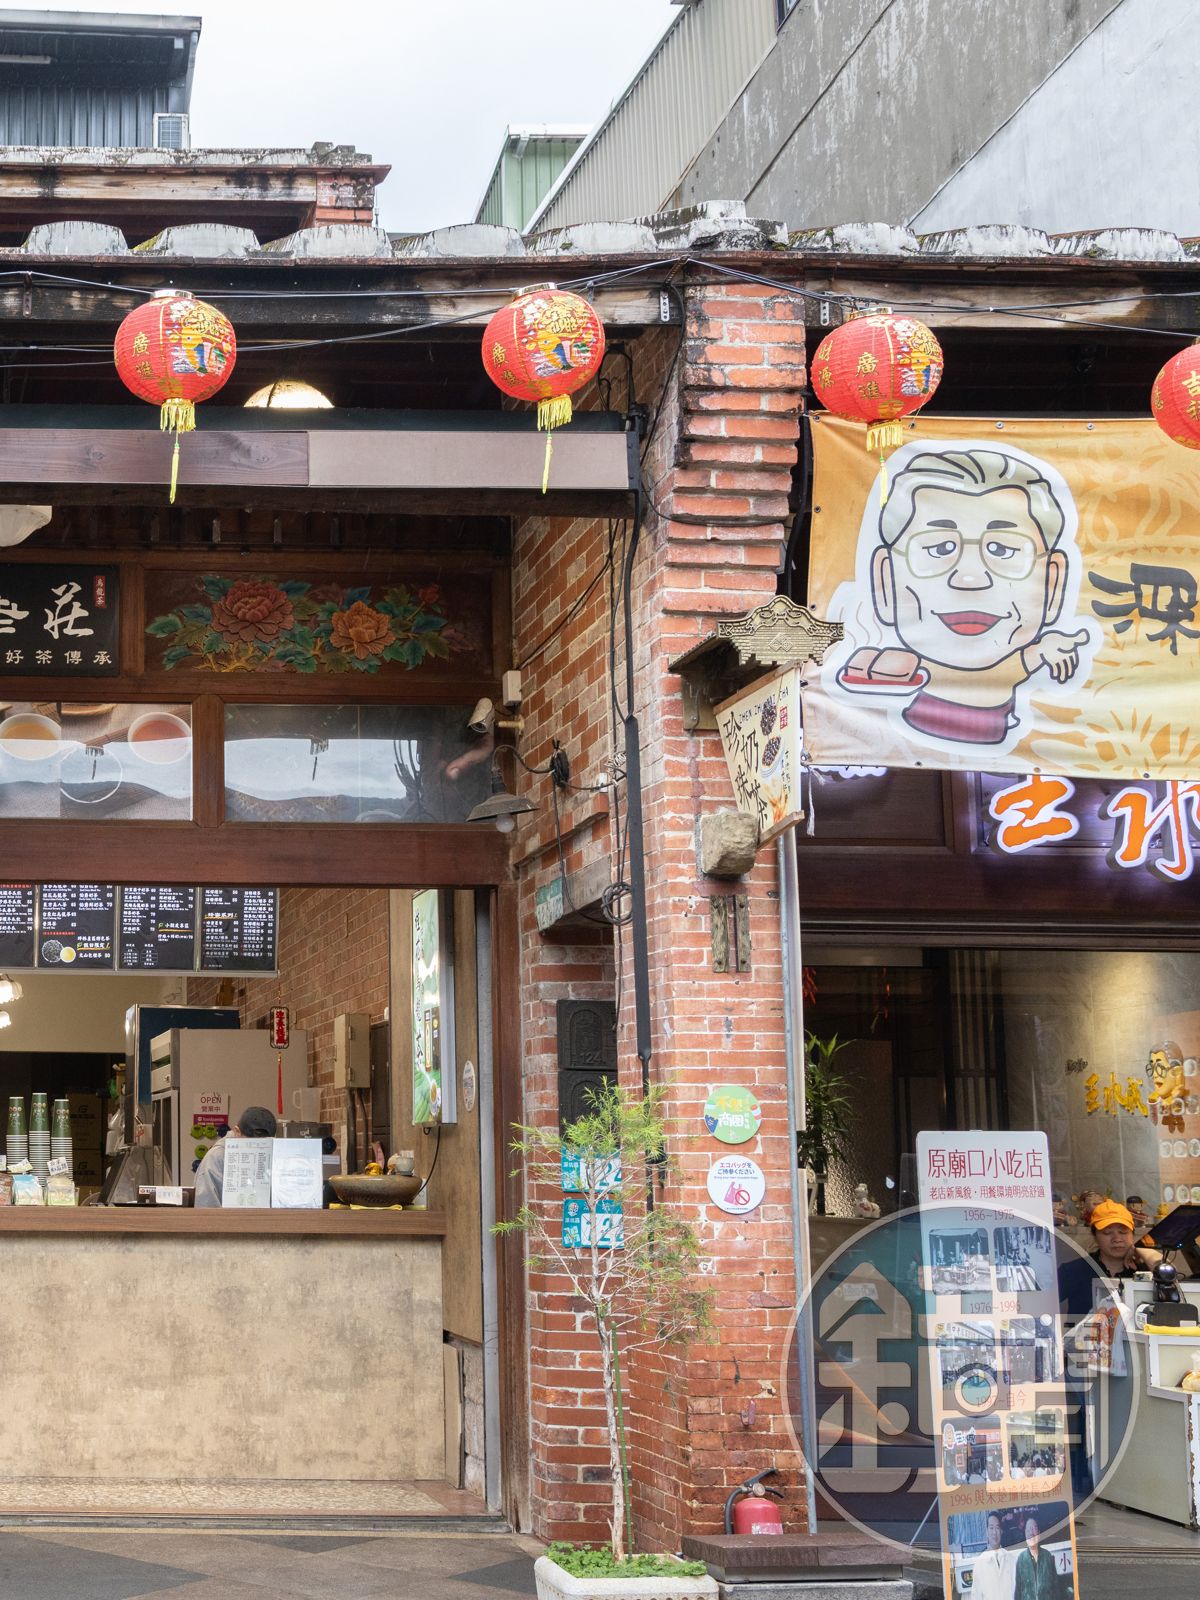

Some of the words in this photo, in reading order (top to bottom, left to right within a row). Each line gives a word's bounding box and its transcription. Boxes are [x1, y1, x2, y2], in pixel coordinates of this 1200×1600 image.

[132, 331, 154, 378] 廣進
[856, 351, 883, 400] 廣進
[927, 1148, 1043, 1179] 原廟口小吃店
